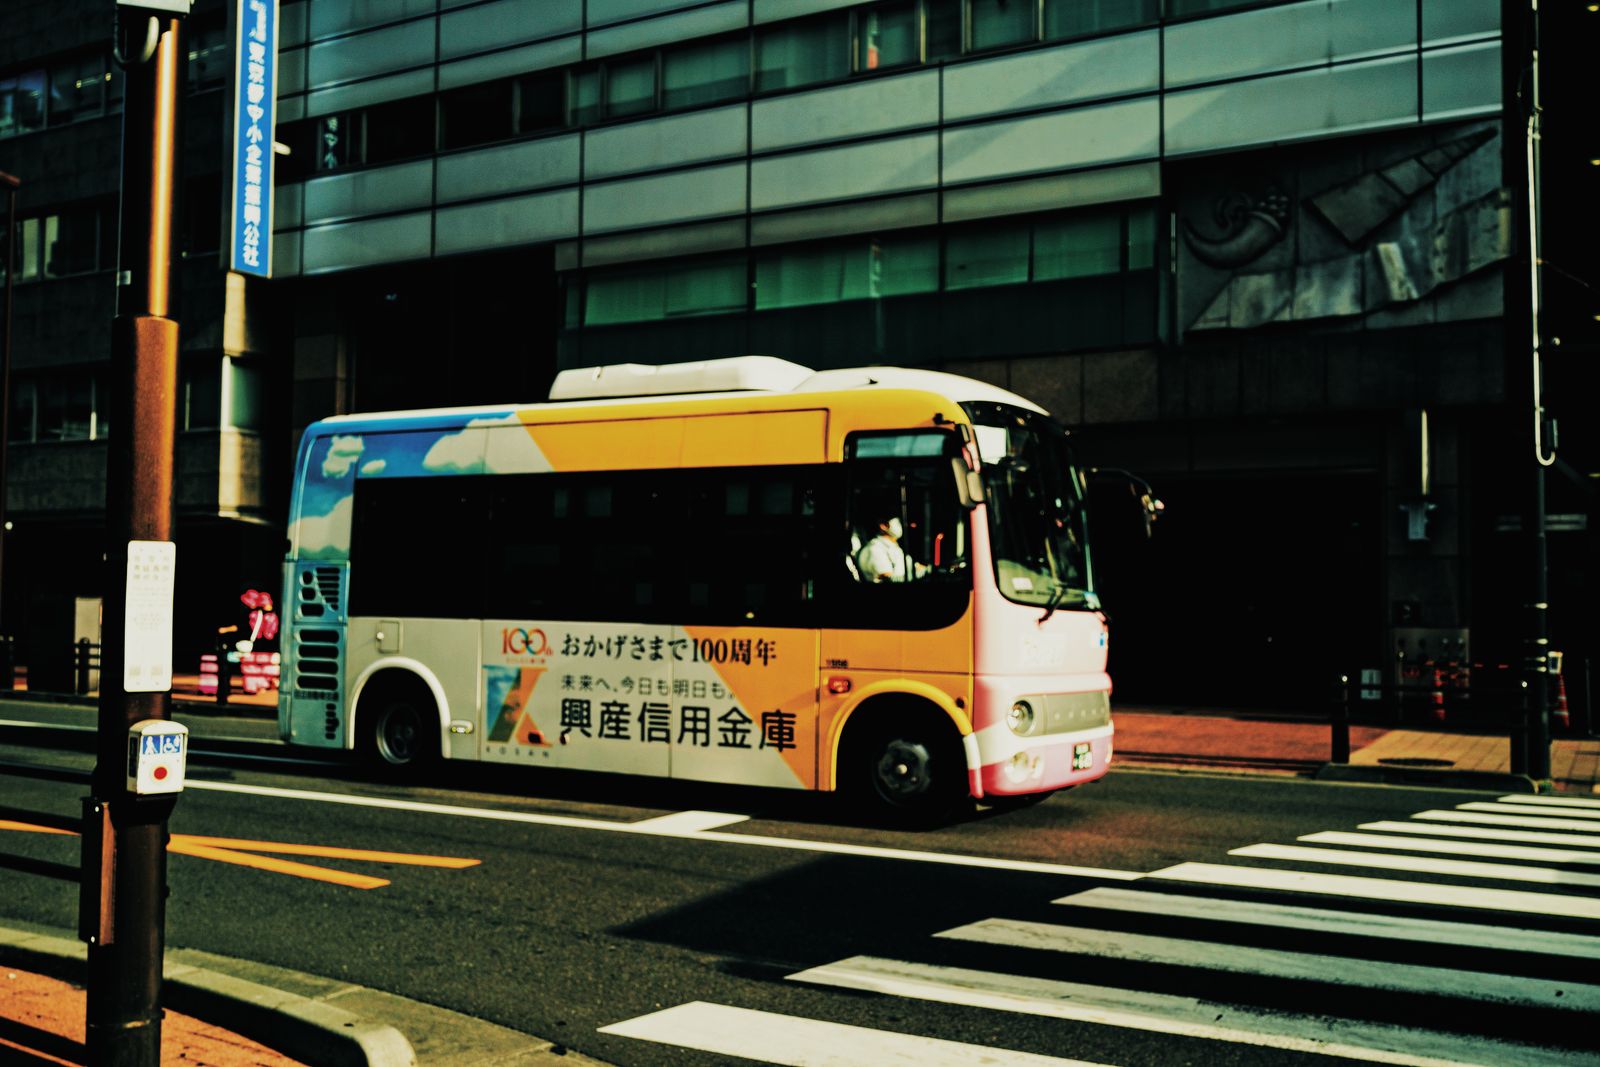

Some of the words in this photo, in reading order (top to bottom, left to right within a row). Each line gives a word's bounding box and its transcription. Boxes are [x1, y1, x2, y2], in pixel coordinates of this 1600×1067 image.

[560, 633, 777, 667] おかげさまで100周年
[559, 697, 797, 752] 興産信用金庫
